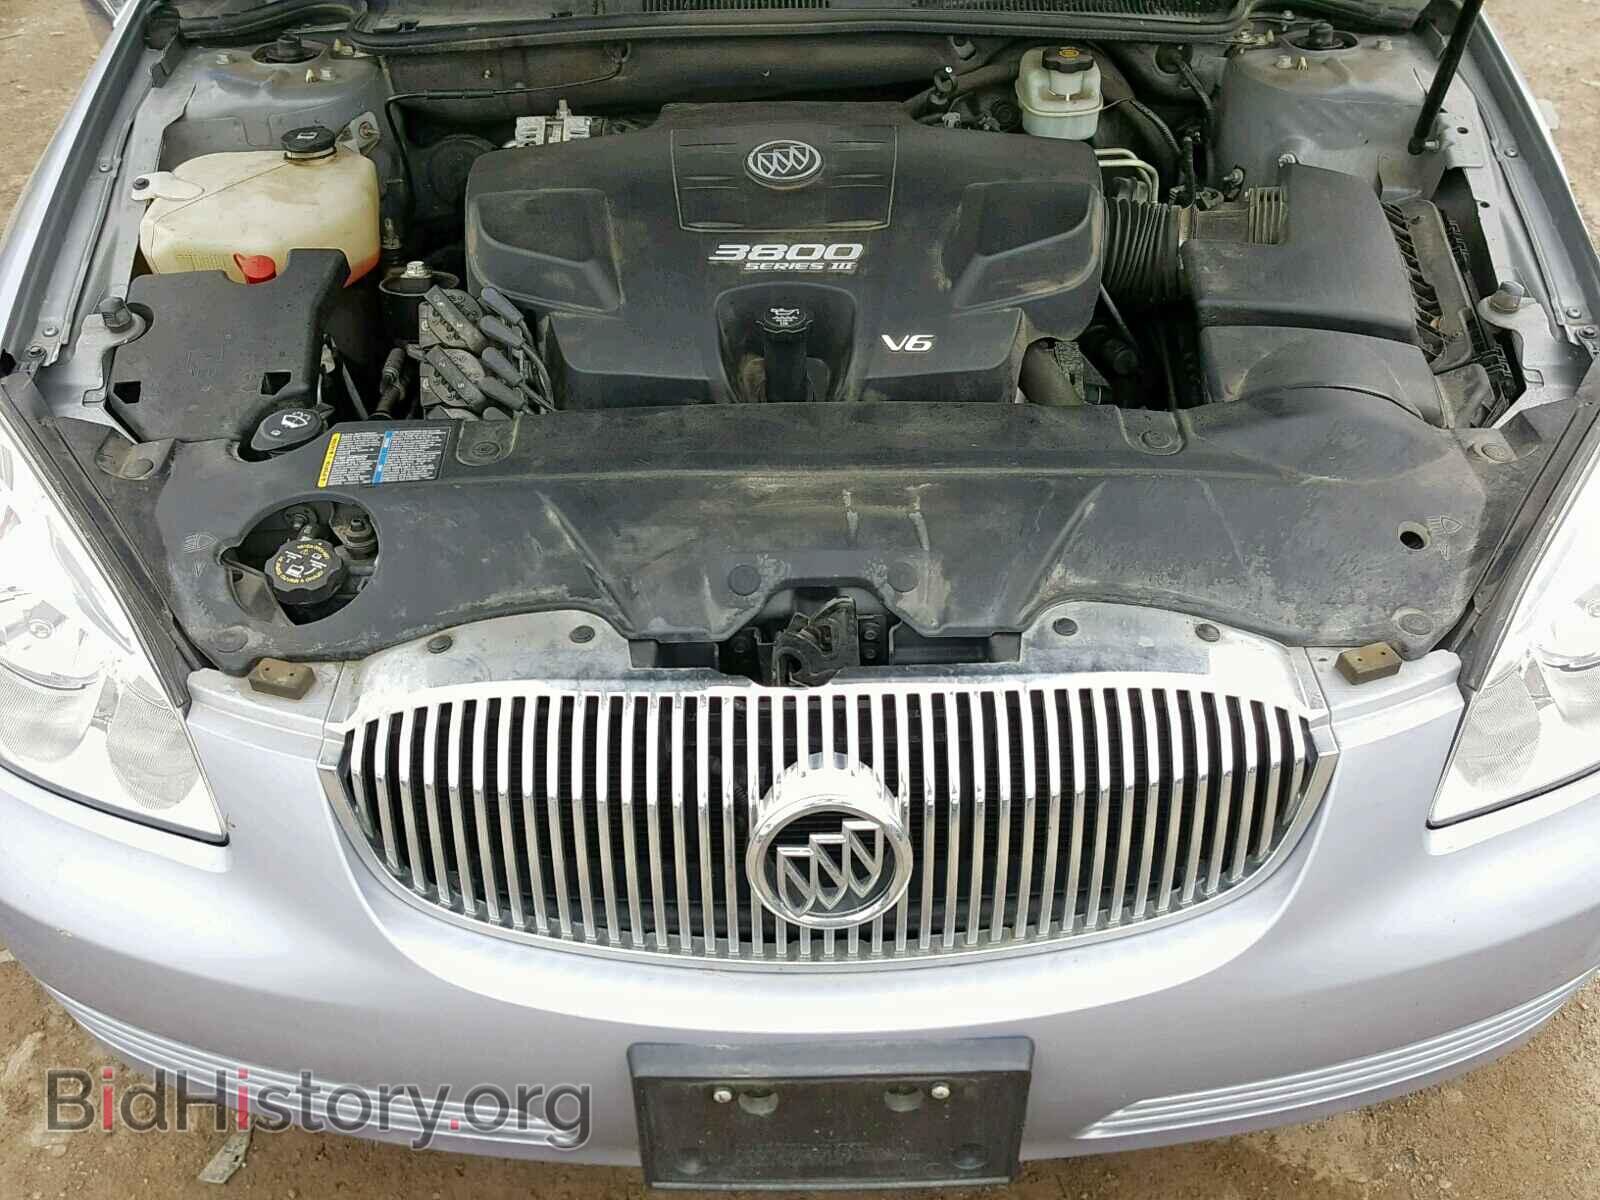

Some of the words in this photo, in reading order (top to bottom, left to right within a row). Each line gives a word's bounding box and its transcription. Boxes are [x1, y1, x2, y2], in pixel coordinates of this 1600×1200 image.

[709, 243, 864, 261] 3800
[744, 262, 823, 270] SERIES
[831, 262, 856, 270] III
[881, 334, 936, 352] V6
